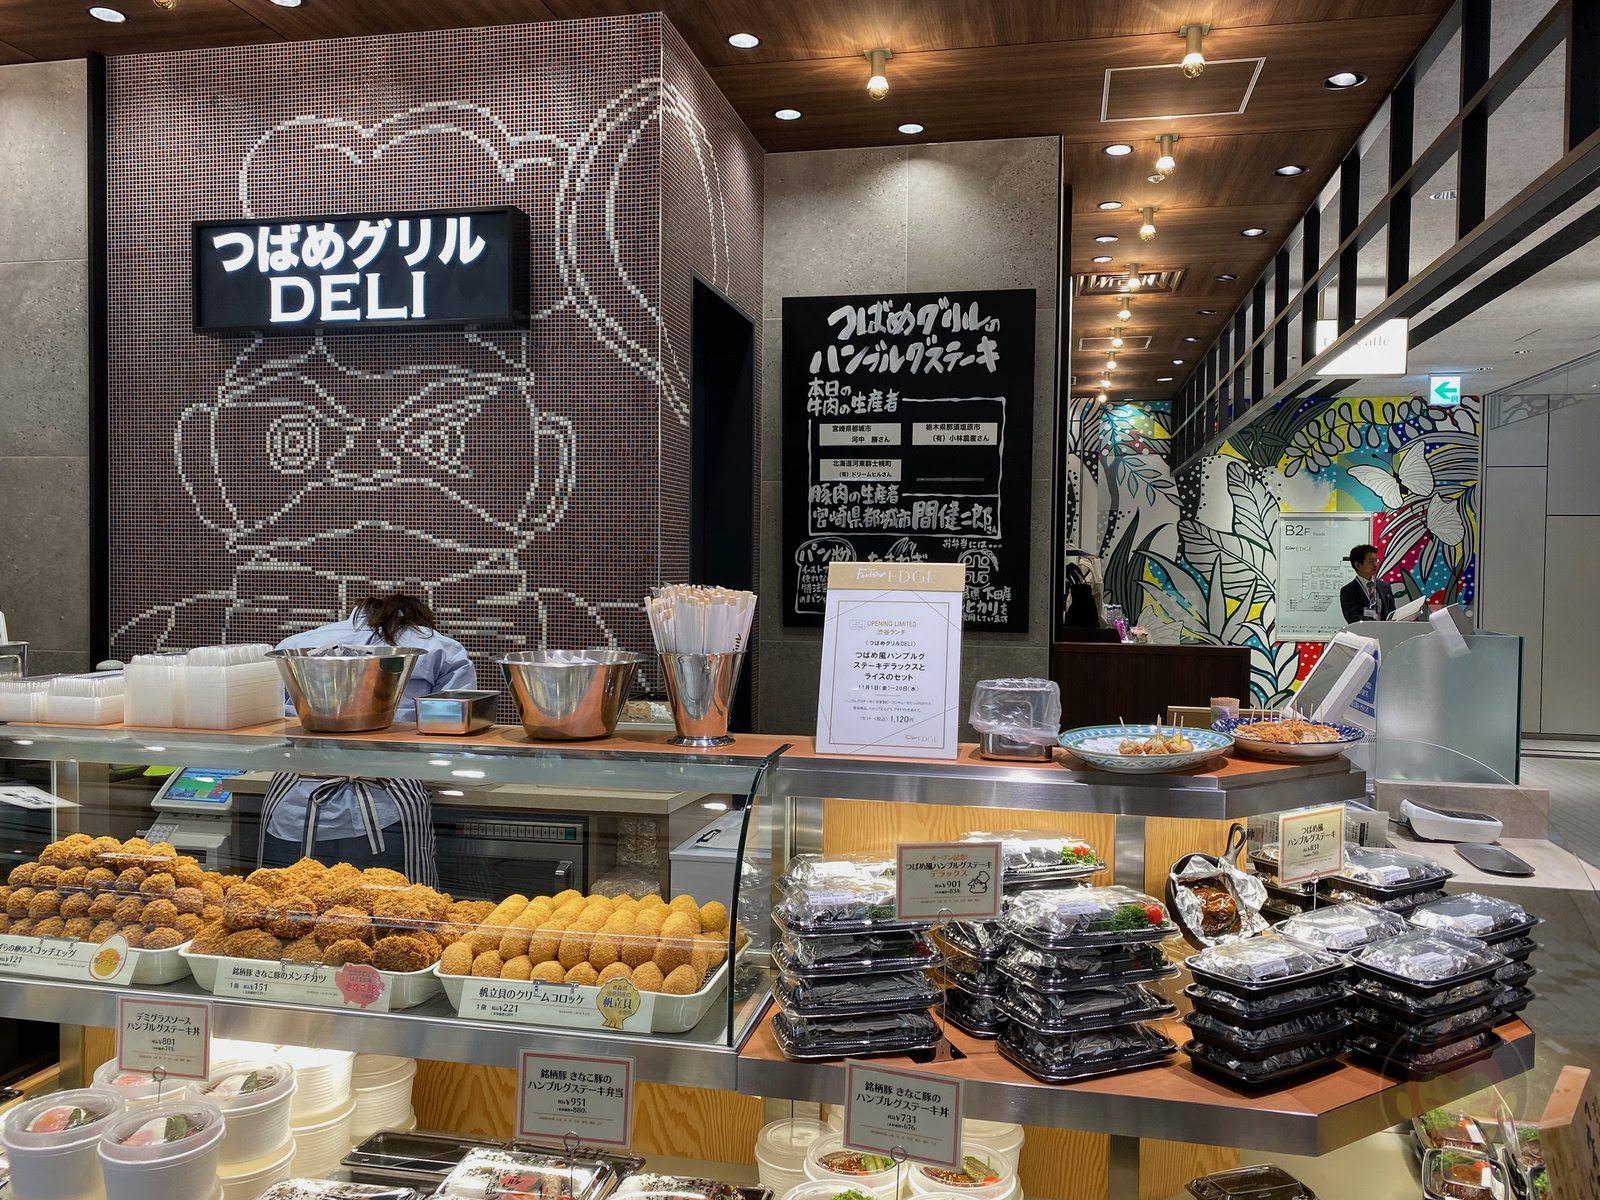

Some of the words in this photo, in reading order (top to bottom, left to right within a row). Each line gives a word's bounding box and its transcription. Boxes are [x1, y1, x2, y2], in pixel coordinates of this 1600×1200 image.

[212, 216, 486, 273] つばめグリル
[269, 270, 426, 322] DELI
[827, 296, 1000, 340] つばめグリルの
[810, 334, 1000, 374] ハンブルグステーキ
[807, 376, 852, 397] 本日の
[808, 484, 900, 505] 豚肉の生産者
[1285, 524, 1311, 536] B2F
[856, 651, 925, 660] つばめ風ハンブルグ
[853, 661, 926, 671] ステーキデラックスと
[865, 672, 914, 681] ライスのセット
[1302, 823, 1324, 834] つばめ風
[1288, 830, 1335, 846] ハンブルグステーキ
[906, 861, 991, 870] つばめ風ハンブルグステーキ
[930, 869, 968, 878] デラックス
[232, 967, 252, 976] 銘柄豚
[254, 969, 327, 983] きなこ豚のメンチカツ
[479, 987, 585, 1005] 帆立貝のクリームコロッケ
[603, 996, 632, 1009] 帆立貝
[137, 1012, 191, 1025] デミグラスソース
[127, 1023, 200, 1036] ハンブルグステーキ丼
[540, 1068, 567, 1081] 銘柄豚
[570, 1071, 612, 1084] きなこ豚の
[527, 1081, 624, 1098] ハンブルグステーキ弁当
[865, 1081, 893, 1096] 銘柄豚
[896, 1087, 941, 1103] きなこ豚の
[856, 1093, 949, 1118] ハンブルグステーキ丼
